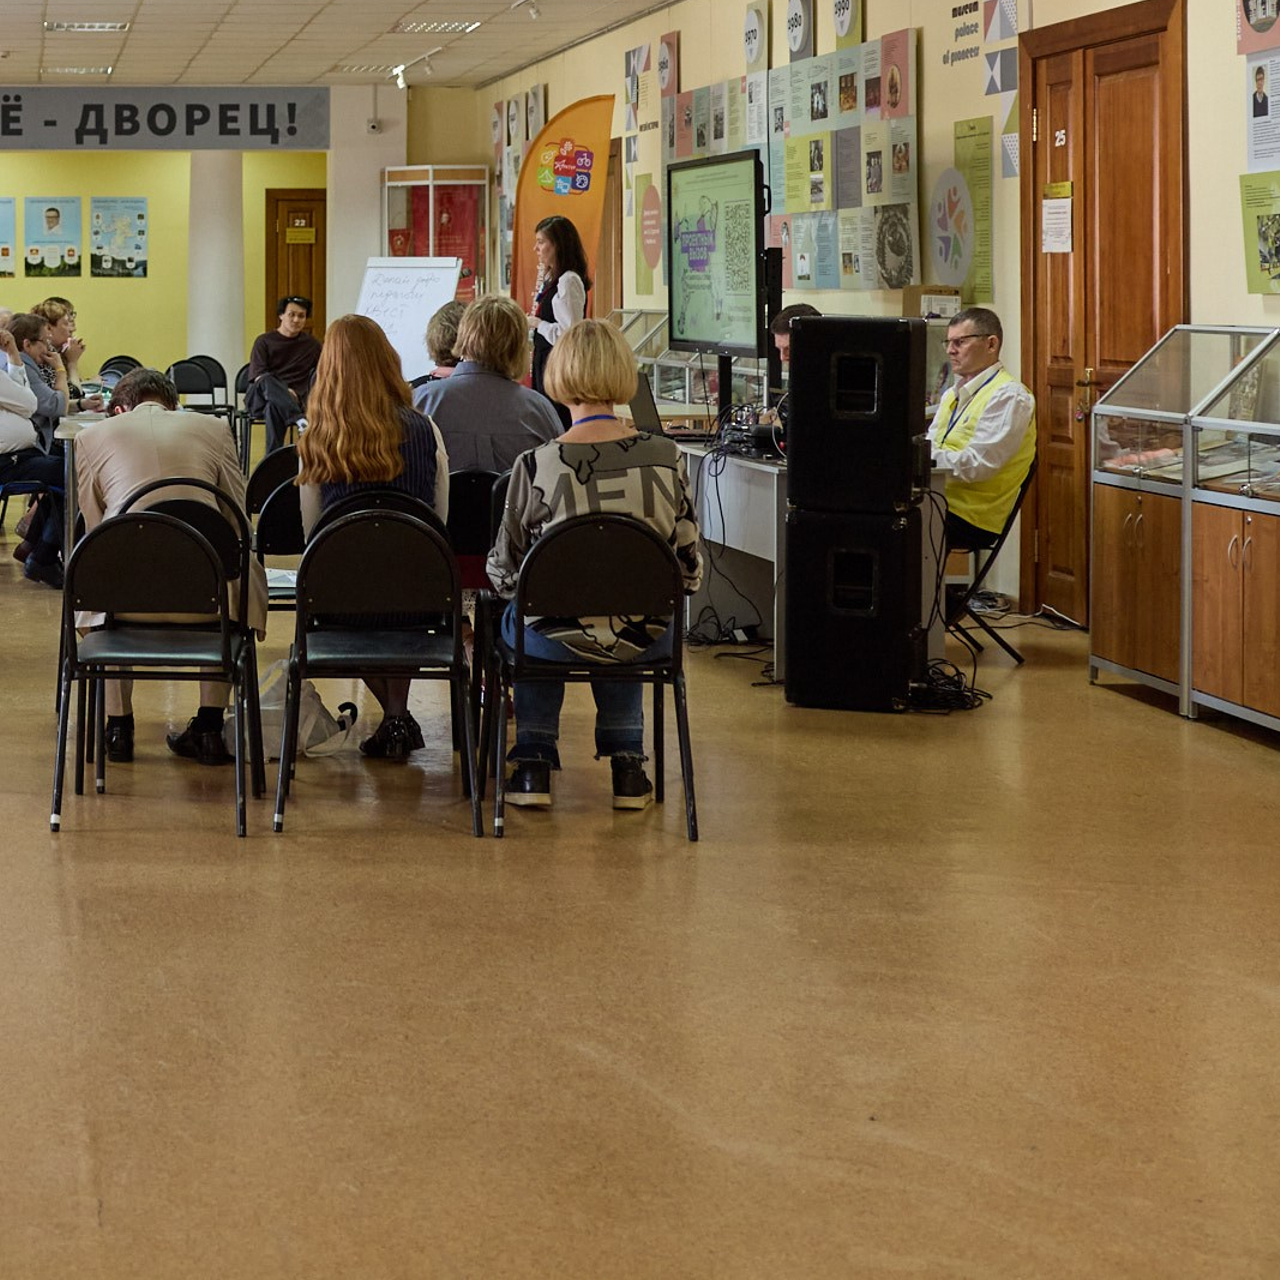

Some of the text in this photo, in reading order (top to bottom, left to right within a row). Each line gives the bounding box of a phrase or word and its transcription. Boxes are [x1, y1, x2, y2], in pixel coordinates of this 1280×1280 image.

[951, 0, 979, 19] museum
[787, 12, 802, 33] 1980
[954, 21, 979, 42] palace
[942, 49, 950, 65] of
[75, 102, 297, 145] ДВОРЕЦ!
[1055, 129, 1066, 147] 25
[294, 219, 306, 227] 22
